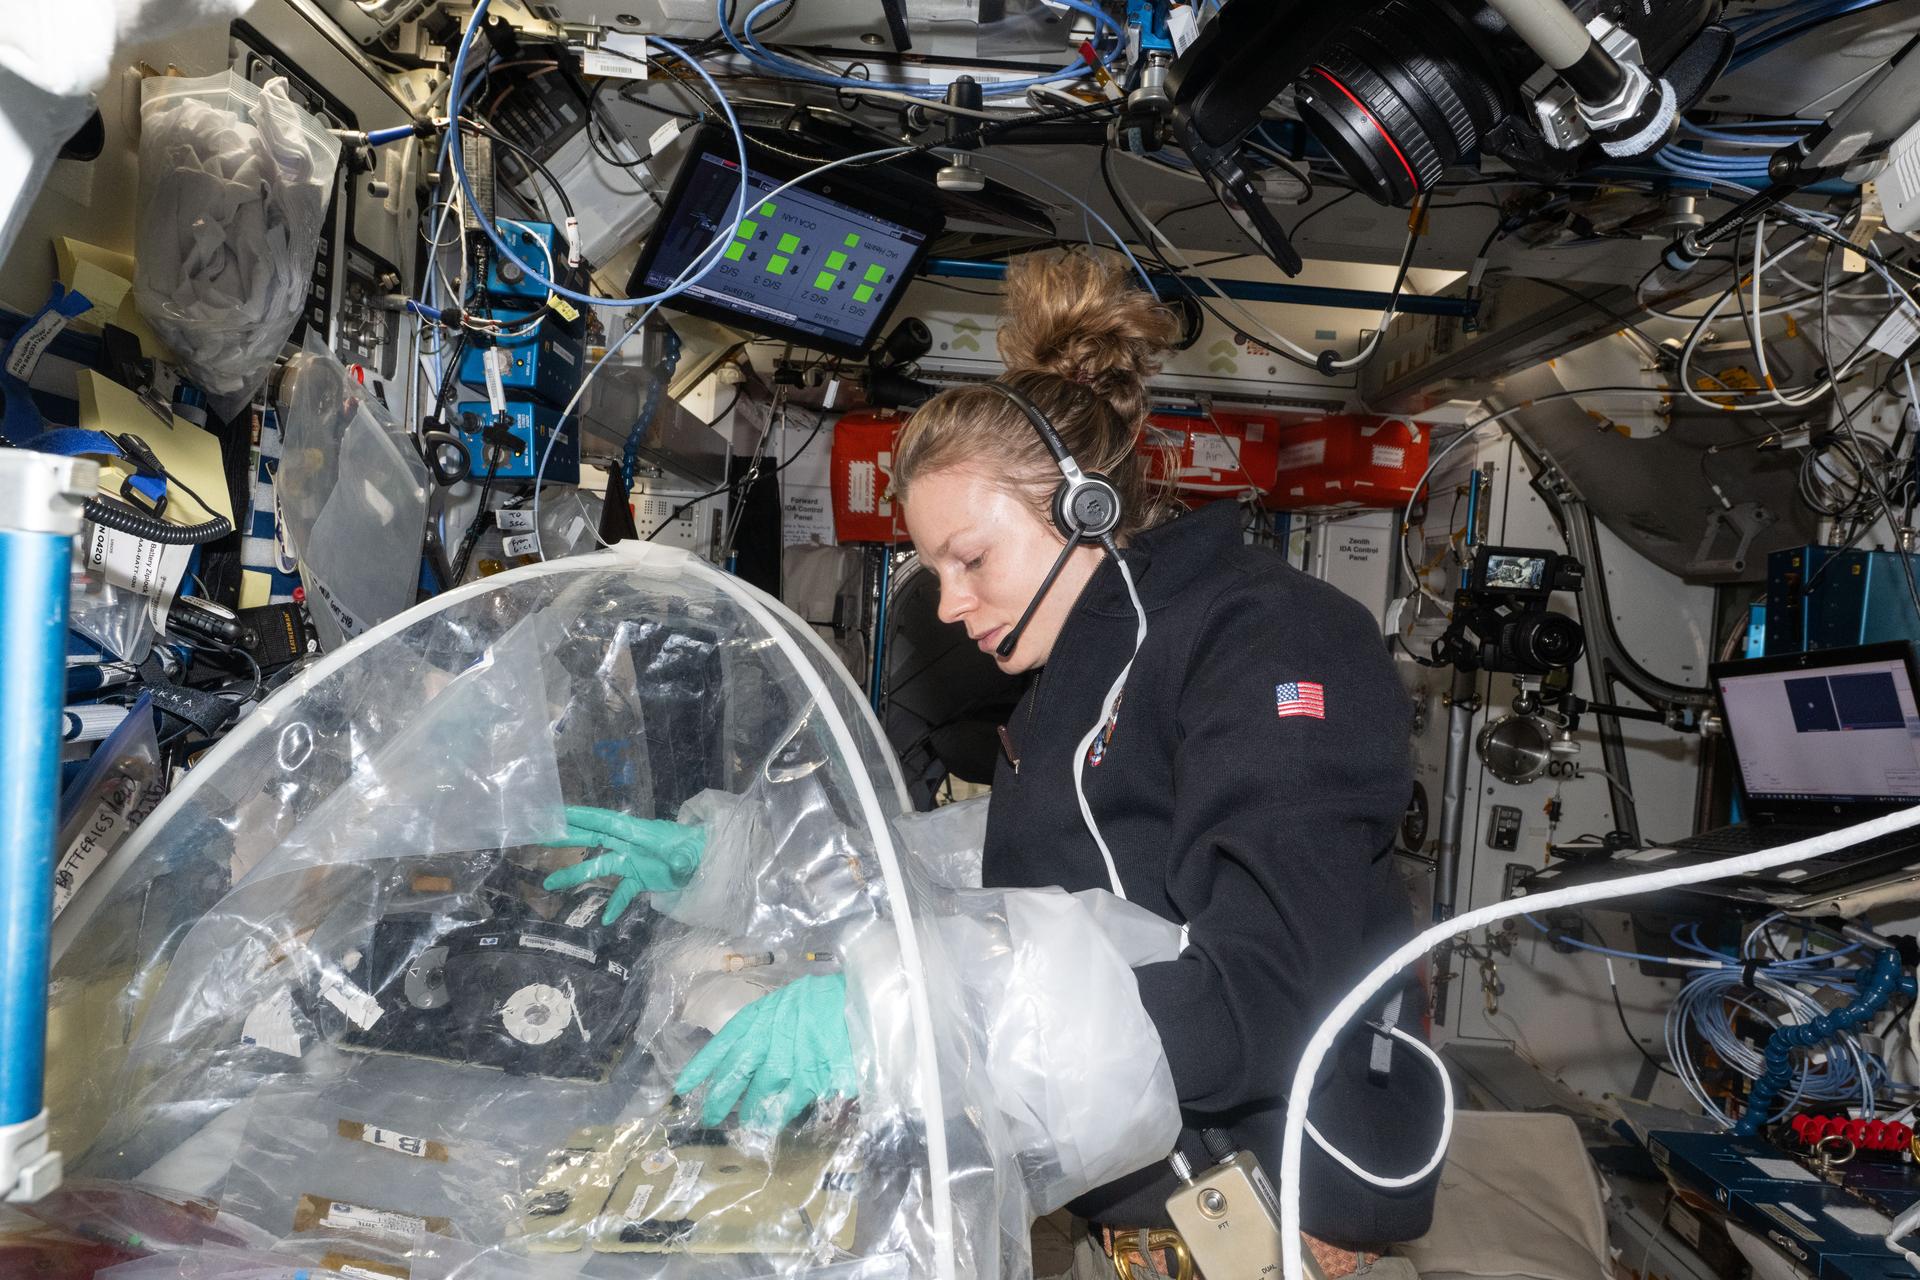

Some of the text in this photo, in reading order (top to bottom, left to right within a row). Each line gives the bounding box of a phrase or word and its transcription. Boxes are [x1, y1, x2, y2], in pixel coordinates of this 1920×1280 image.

[753, 275, 761, 284] 3
[801, 290, 810, 299] 2
[790, 497, 818, 505] Forward
[1353, 546, 1379, 554] Control
[142, 543, 157, 593] Battery Ziplock
[283, 611, 297, 653] LEATHERMAN
[1549, 760, 1585, 778] COL
[1218, 1221, 1230, 1230] PTT
[1261, 1264, 1278, 1275] DUAL
